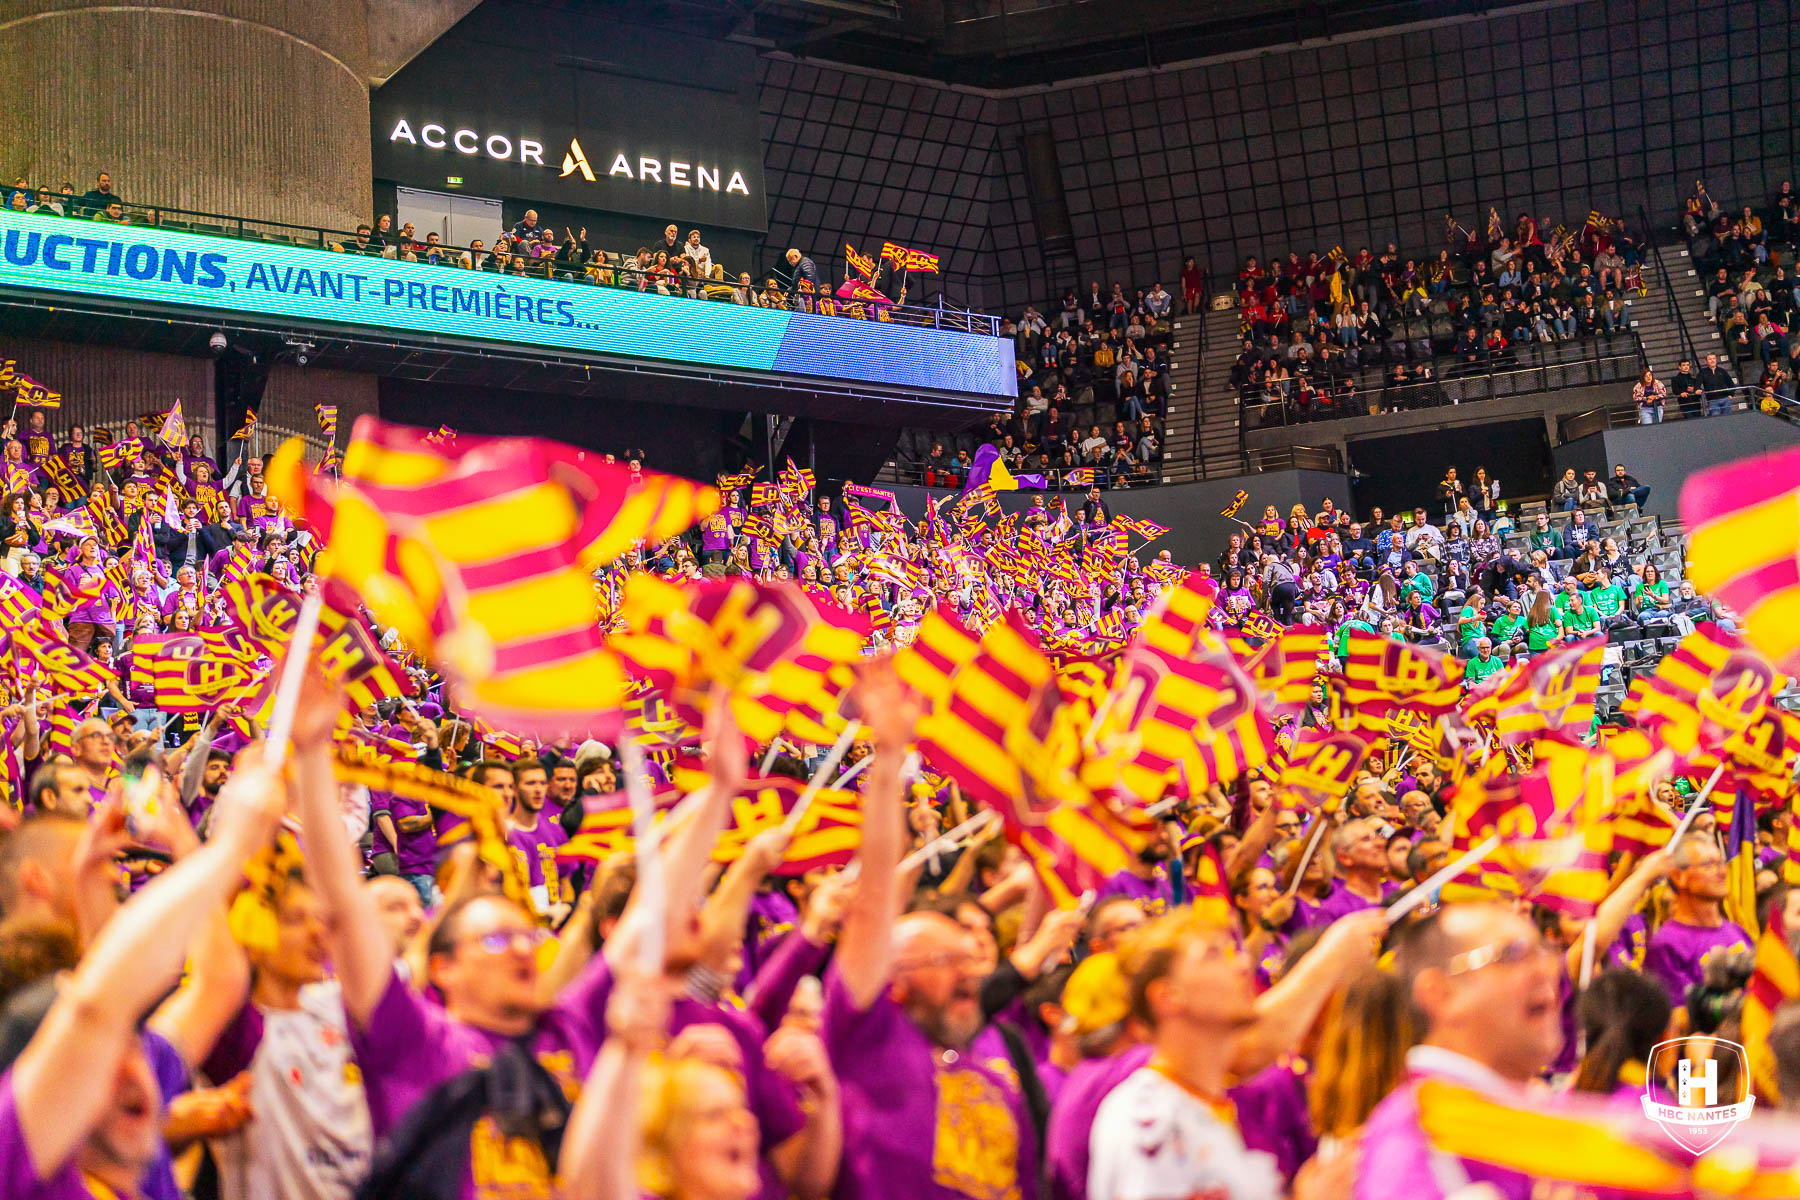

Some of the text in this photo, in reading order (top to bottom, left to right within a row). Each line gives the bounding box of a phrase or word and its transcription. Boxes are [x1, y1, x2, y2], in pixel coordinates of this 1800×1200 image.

[390, 118, 544, 165] ACCOR
[609, 153, 749, 195] ARENA
[0, 229, 600, 331] UCTIONS, AVANT-PREMIÈRES...
[34, 391, 43, 399] H
[59, 473, 72, 485] H
[768, 490, 777, 498] H
[761, 525, 770, 535] H
[891, 559, 903, 571] H
[970, 560, 980, 572] H
[1005, 557, 1014, 569] H
[267, 599, 297, 626] H
[1258, 619, 1268, 631] H
[321, 633, 364, 676] H
[200, 662, 223, 683] H
[1402, 650, 1428, 681] H
[1396, 708, 1413, 726] H
[1306, 746, 1353, 783] H
